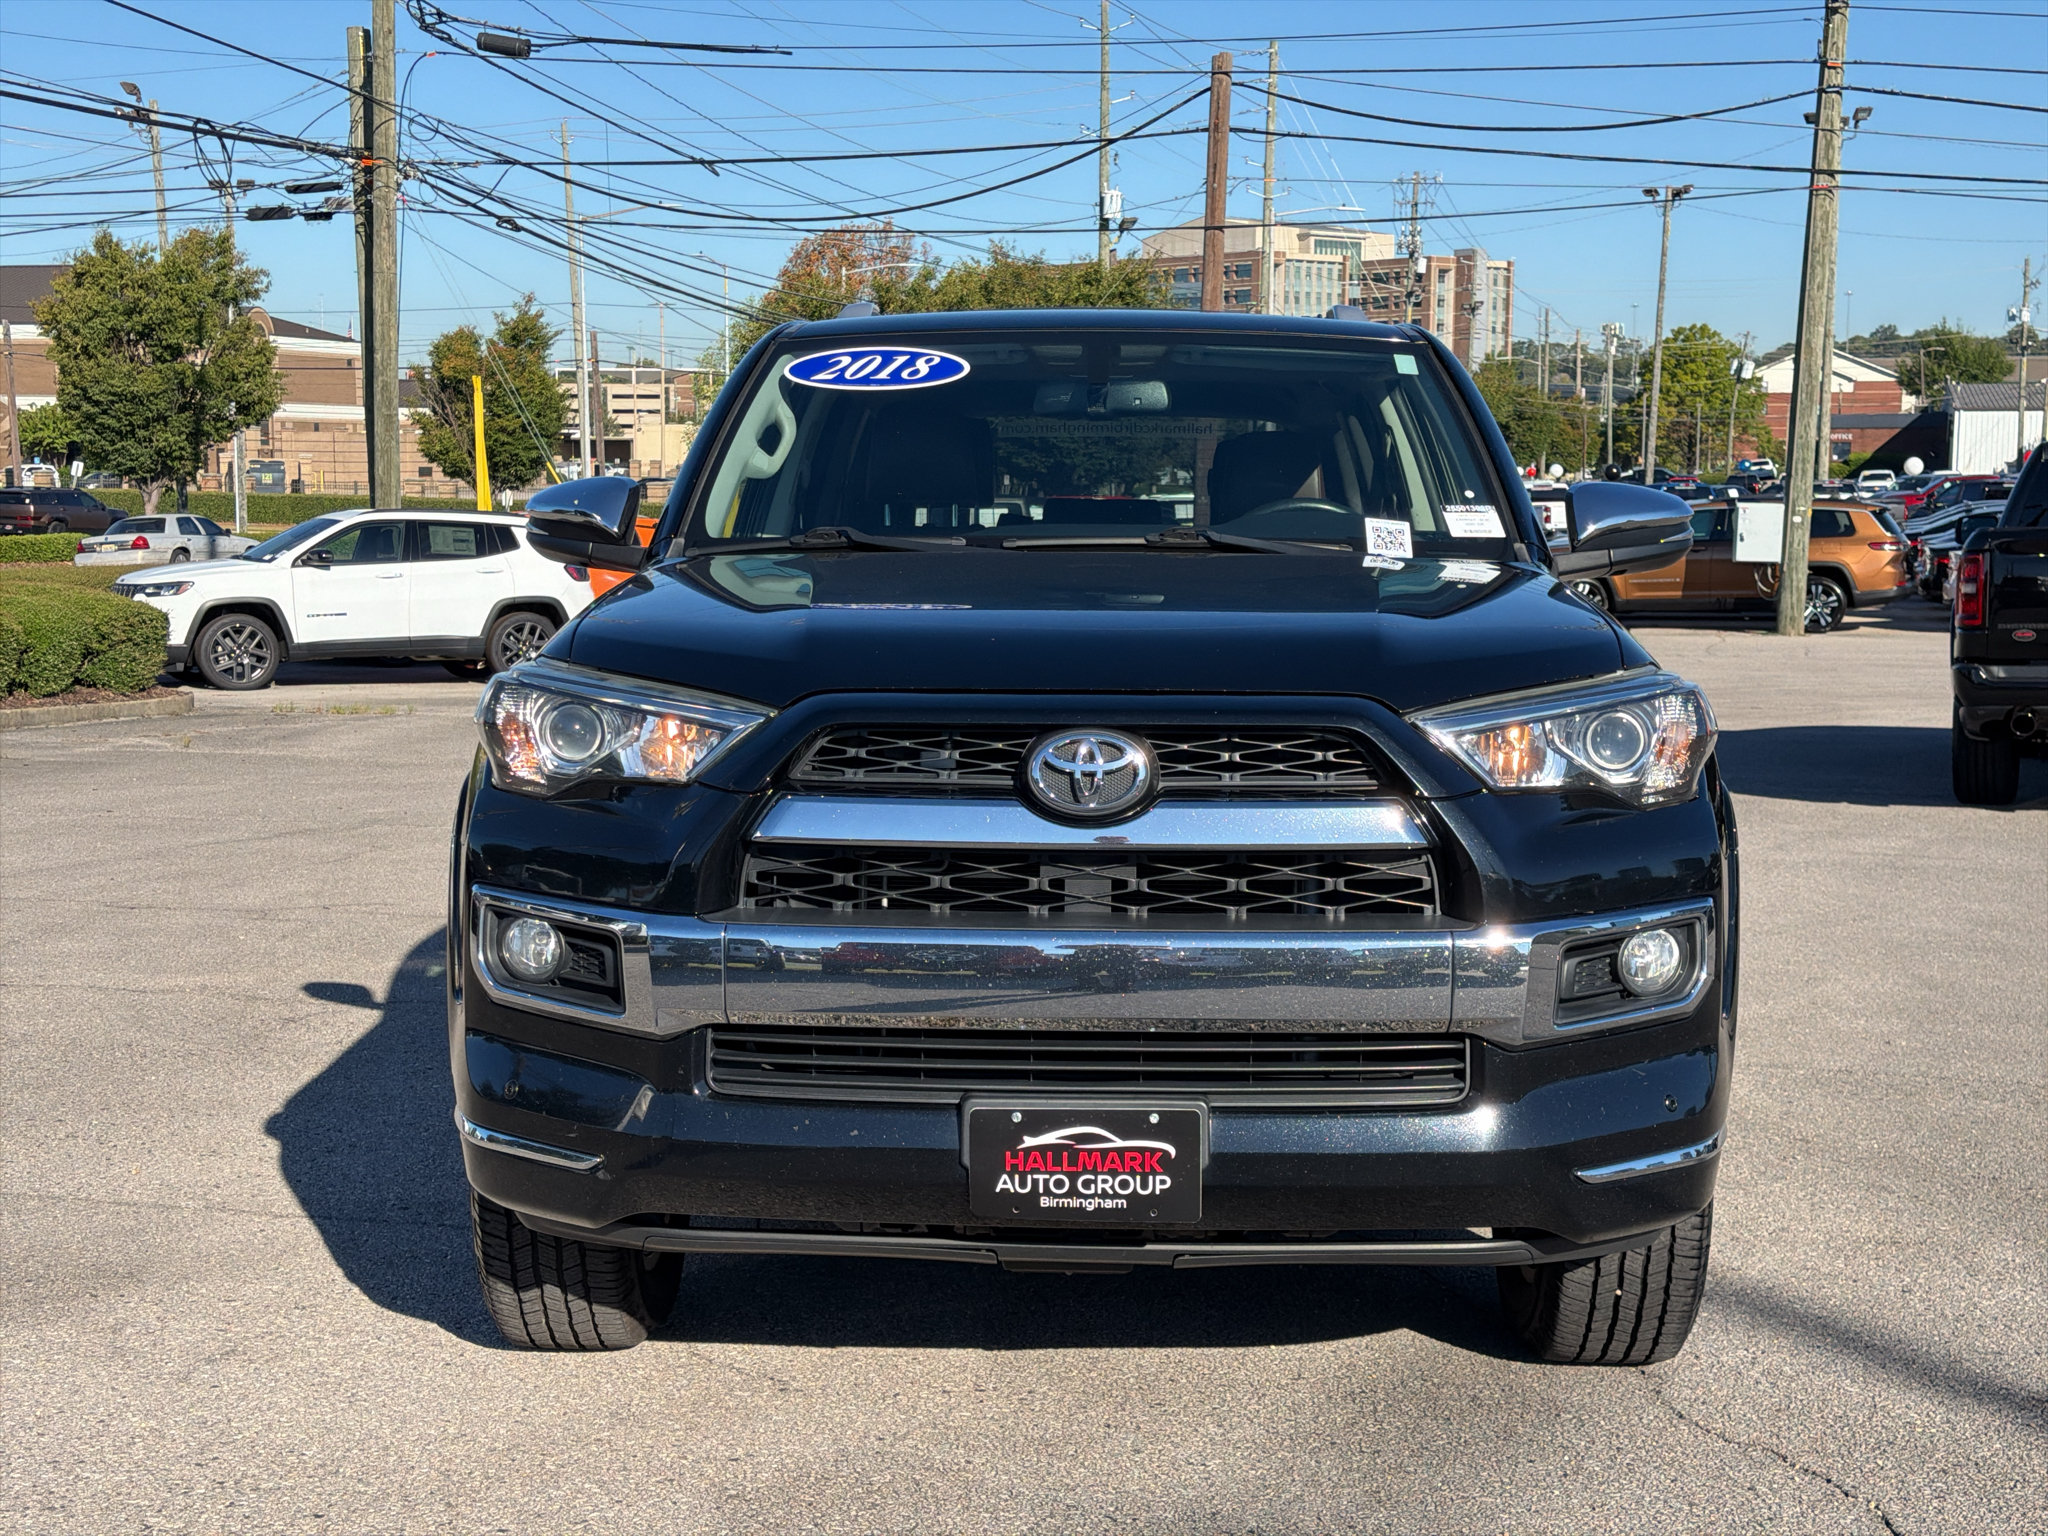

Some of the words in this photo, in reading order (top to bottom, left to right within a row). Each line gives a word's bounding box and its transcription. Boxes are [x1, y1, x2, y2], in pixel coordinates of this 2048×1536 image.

[810, 355, 942, 380] 2018
[1004, 1151, 1164, 1173] HALLMARK
[995, 1174, 1070, 1195] AUTO
[1077, 1174, 1172, 1195] GROUP
[1039, 1196, 1127, 1212] Birmingham
